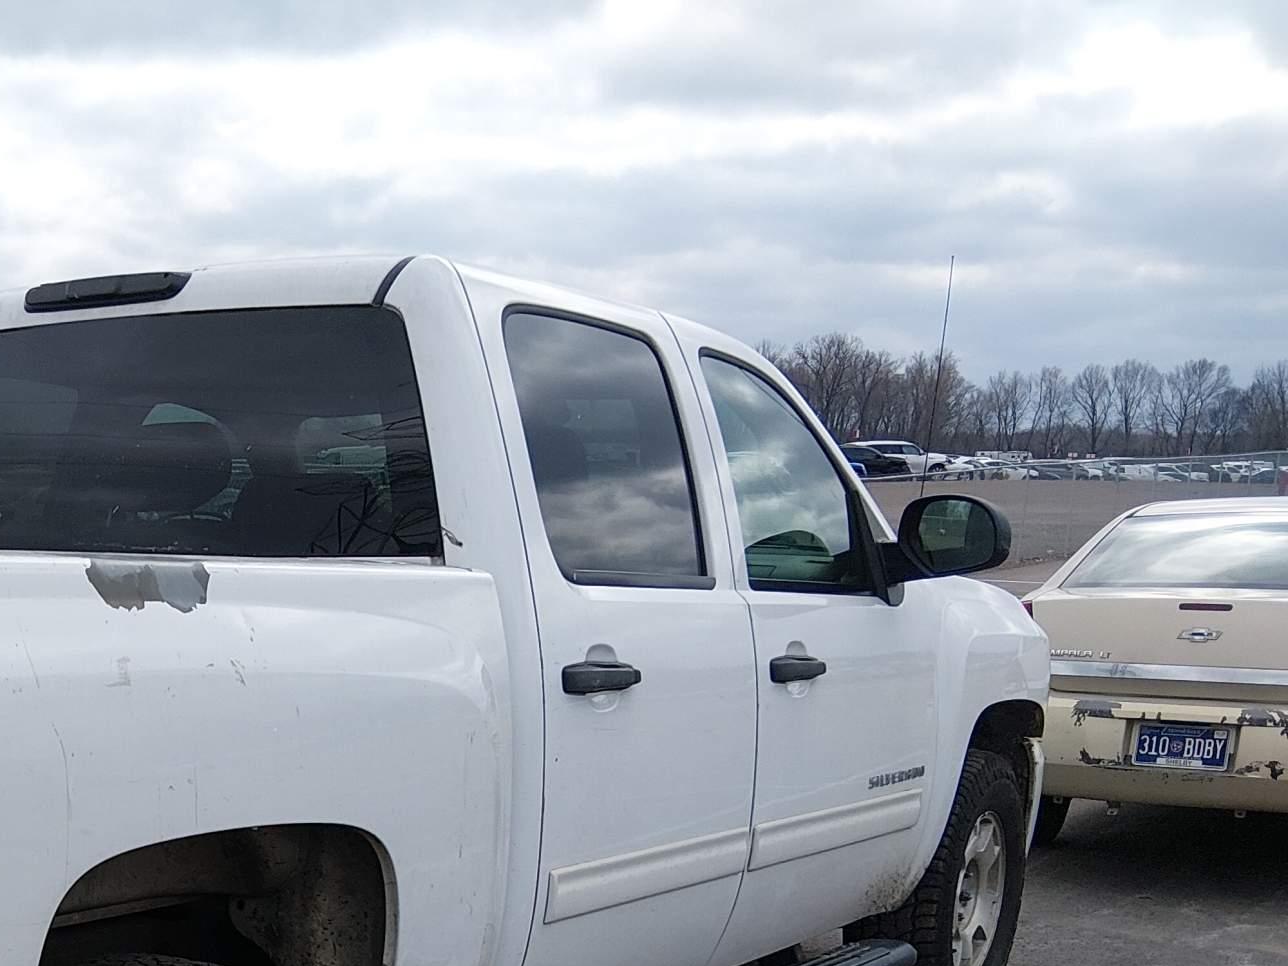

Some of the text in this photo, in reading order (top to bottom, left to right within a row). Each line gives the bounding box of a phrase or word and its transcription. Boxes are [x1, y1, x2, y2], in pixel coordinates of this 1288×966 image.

[1050, 648, 1093, 658] MPALA
[1138, 735, 1225, 760] 310 BDBY
